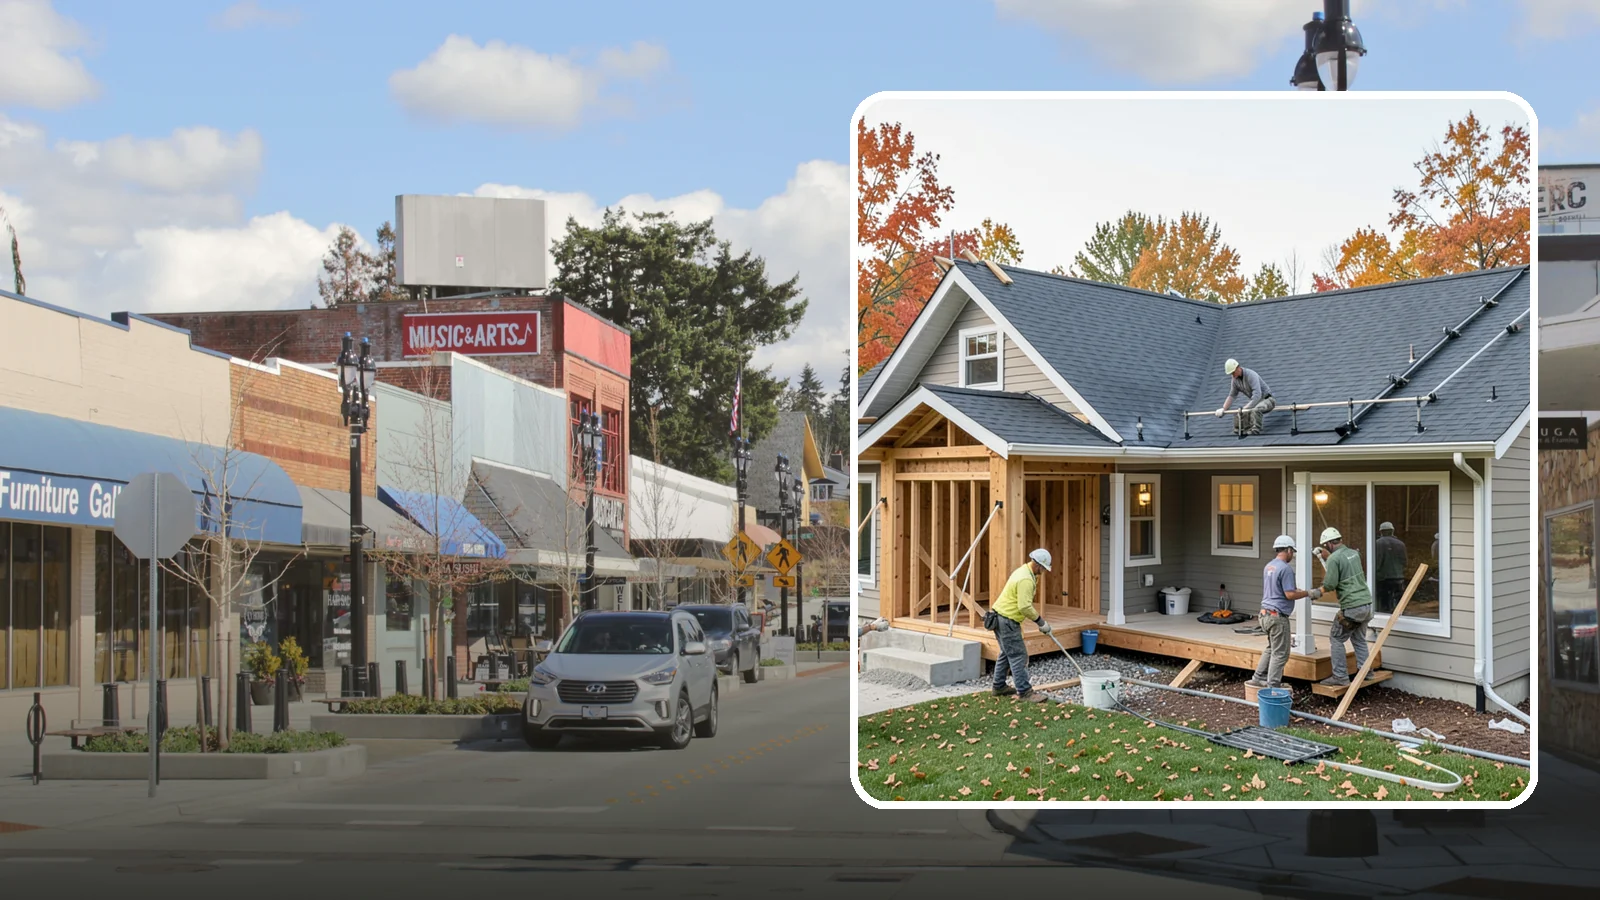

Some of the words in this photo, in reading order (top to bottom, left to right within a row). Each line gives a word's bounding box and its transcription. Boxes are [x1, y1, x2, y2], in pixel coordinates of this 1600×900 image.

[1540, 427, 1577, 437] UGA
[0, 471, 79, 515] Furniture
[89, 482, 122, 519] Gal
